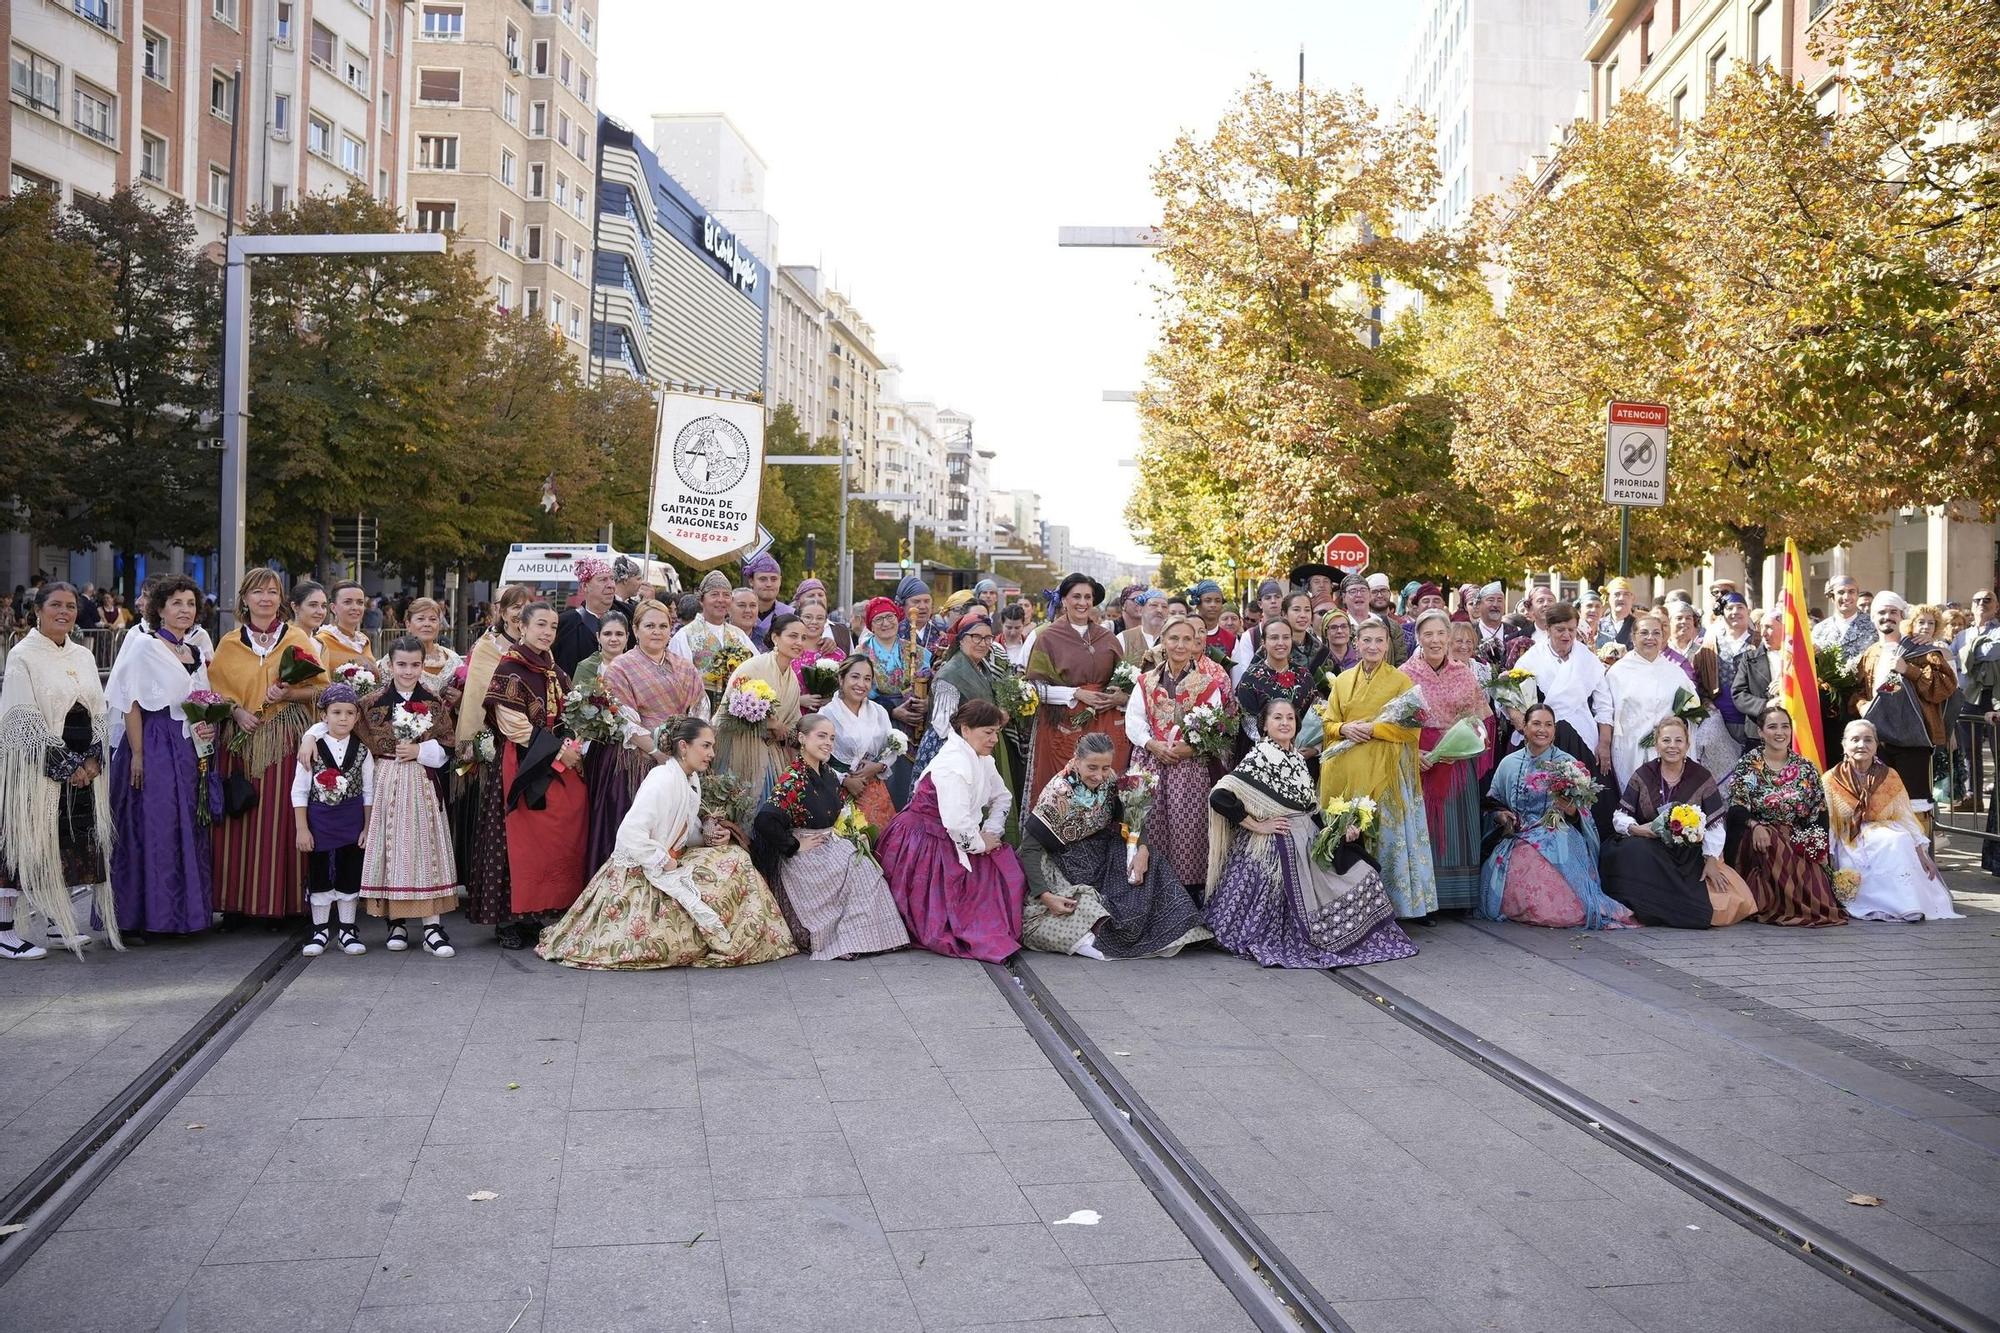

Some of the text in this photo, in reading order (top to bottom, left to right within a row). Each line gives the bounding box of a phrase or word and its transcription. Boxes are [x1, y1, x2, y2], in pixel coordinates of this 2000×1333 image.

[704, 215, 713, 251] El
[714, 226, 733, 267] Corte
[1617, 409, 1661, 420] ATENCIÓN
[1624, 443, 1652, 464] 20
[1614, 478, 1660, 488] PRIORIDAD
[1614, 490, 1658, 500] PEATONAL
[679, 495, 733, 509] BANDA DE
[661, 503, 747, 521] GAITAS DE BOTO
[668, 515, 739, 531] ARAGONESAS
[676, 529, 728, 542] Zaragoza
[1330, 550, 1364, 561] STOP
[517, 563, 575, 573] AMBULAN
